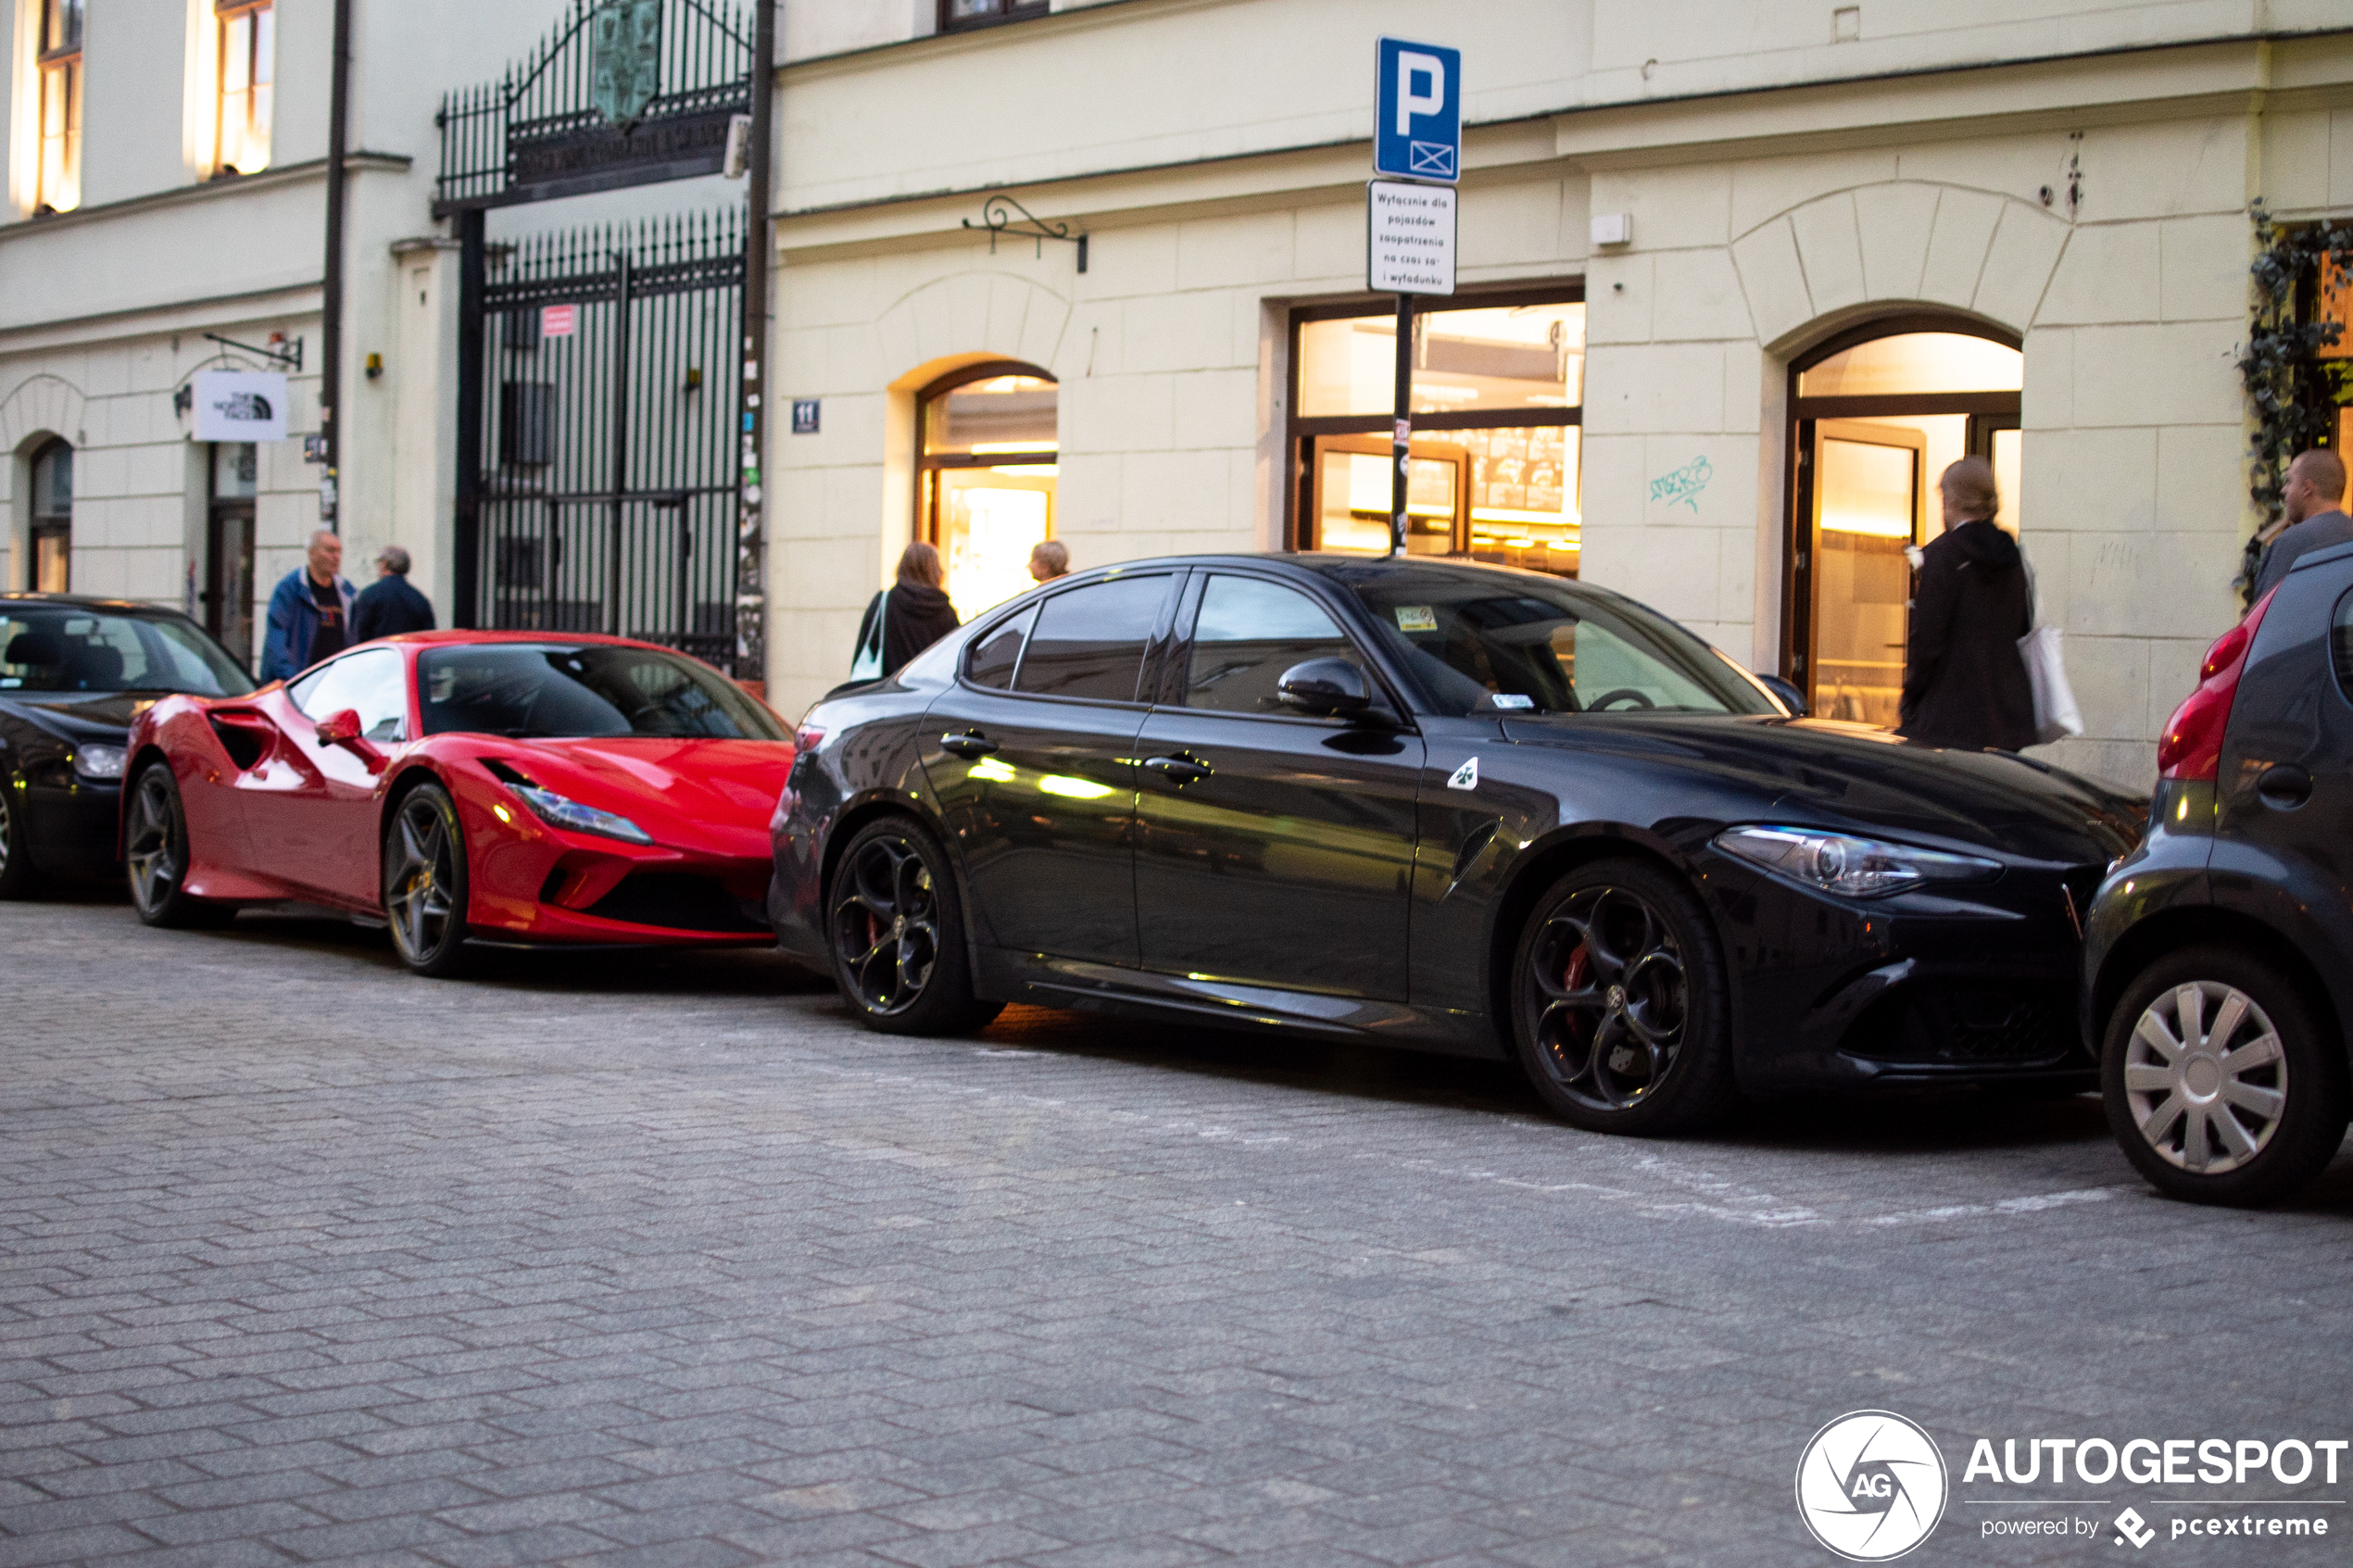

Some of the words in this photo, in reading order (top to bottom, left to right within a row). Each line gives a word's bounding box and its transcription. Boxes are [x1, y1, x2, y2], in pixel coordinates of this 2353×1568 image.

[1397, 50, 1444, 136] P
[1432, 197, 1448, 208] dla
[1388, 215, 1436, 227] pojazdów
[1379, 234, 1443, 246] zaopatrzenia
[1383, 254, 1396, 263] na
[1401, 256, 1421, 265] czas
[1390, 273, 1443, 285] wyładunku
[798, 404, 813, 422] 11
